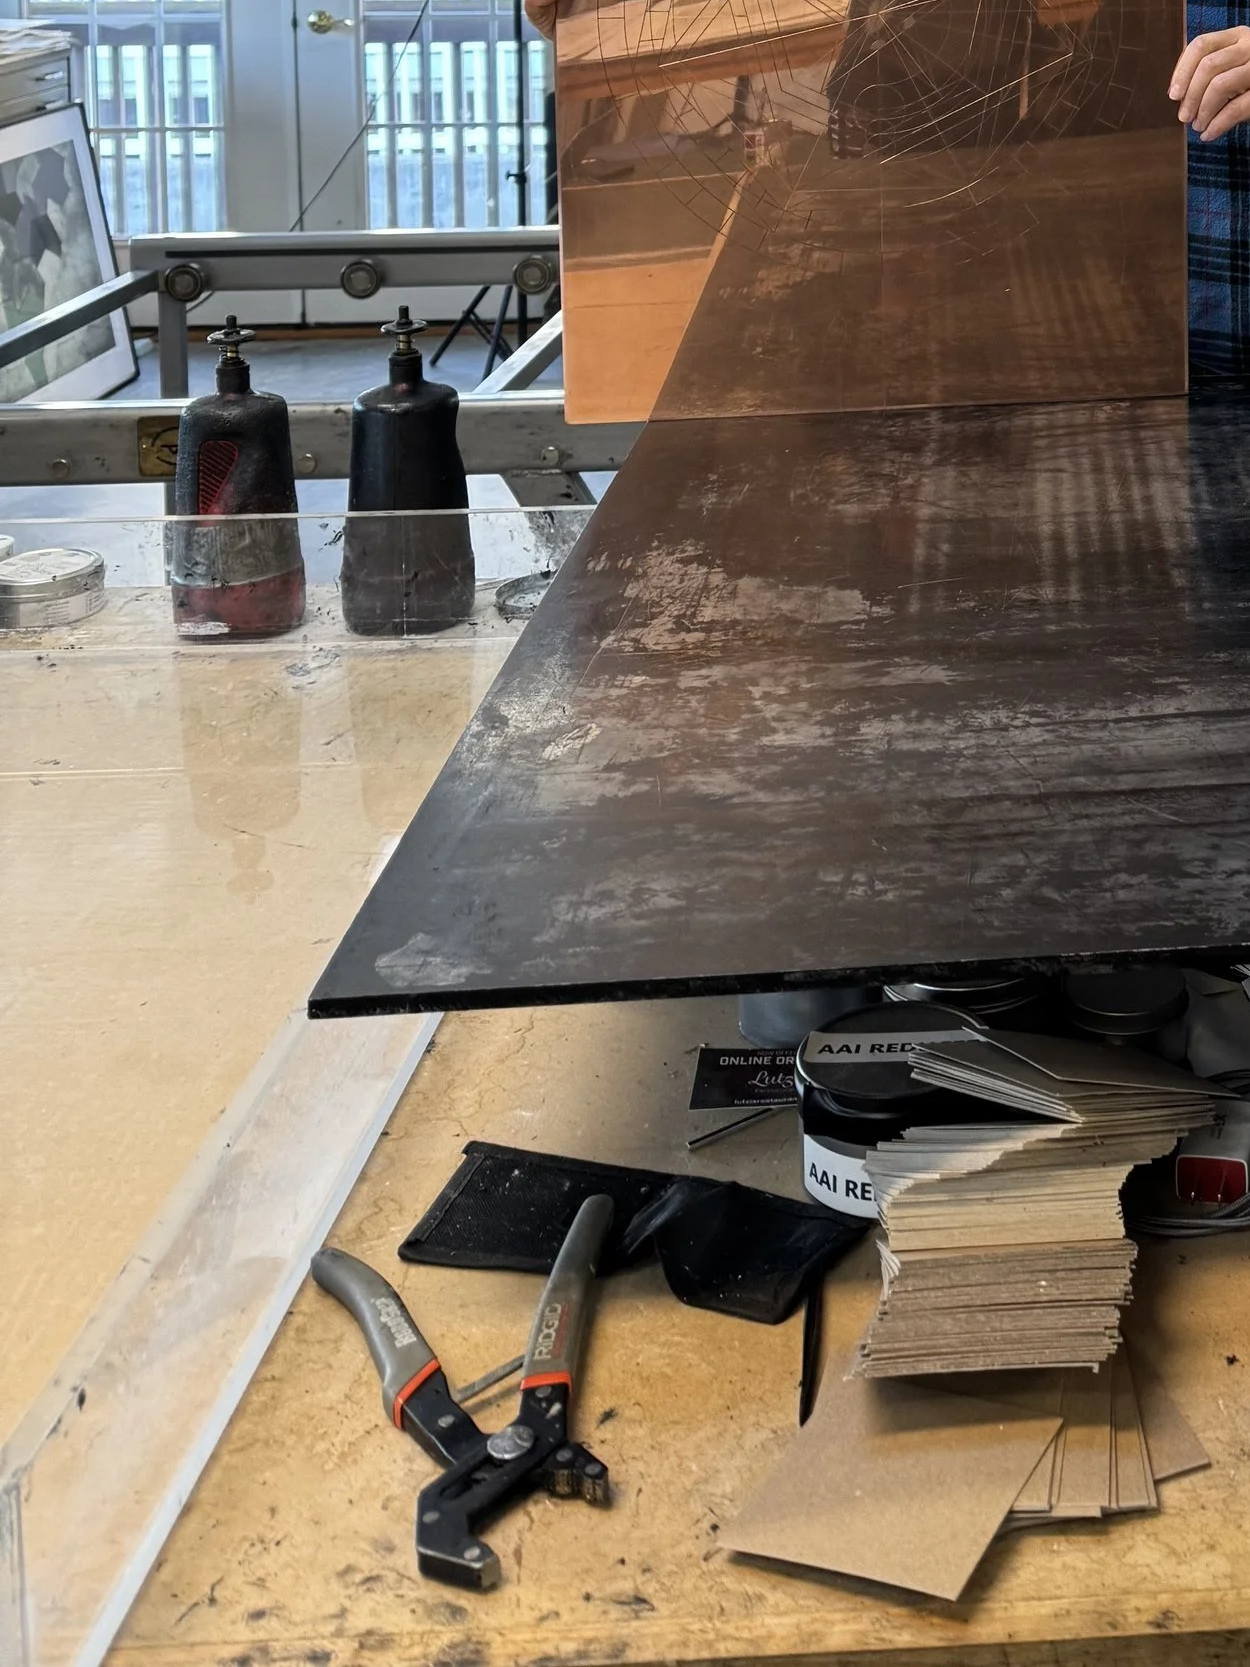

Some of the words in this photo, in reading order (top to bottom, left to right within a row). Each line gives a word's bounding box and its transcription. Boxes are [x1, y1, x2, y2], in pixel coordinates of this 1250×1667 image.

[720, 1056, 772, 1066] ONLINE
[776, 1056, 795, 1065] OR
[817, 1044, 862, 1054] AAI
[809, 1162, 837, 1194] AAI
[845, 1179, 877, 1201] RE
[532, 1302, 562, 1361] RIDGID
